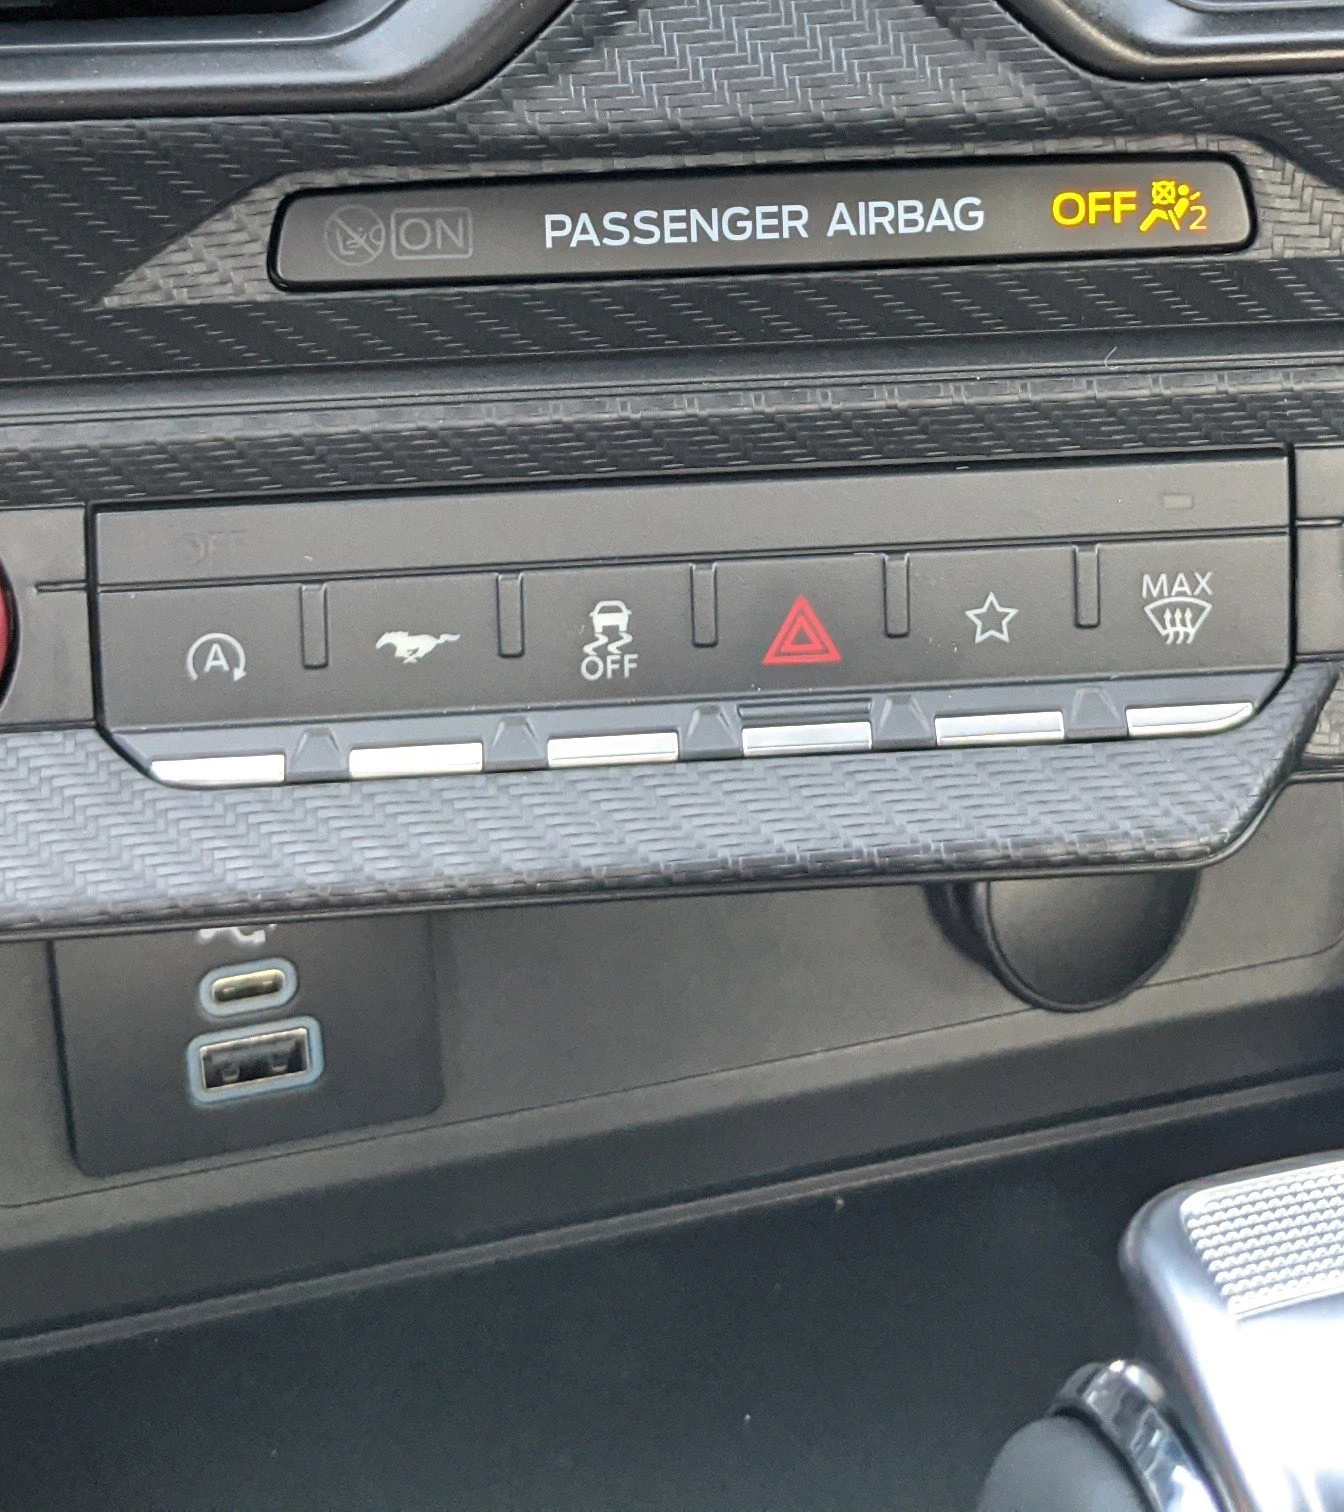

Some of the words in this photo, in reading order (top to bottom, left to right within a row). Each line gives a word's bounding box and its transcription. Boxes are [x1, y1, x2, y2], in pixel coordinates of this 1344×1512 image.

[544, 204, 809, 250] PASSENGER
[826, 197, 985, 238] AIRBAG
[1052, 190, 1138, 227] OFF
[398, 217, 465, 251] ON
[1142, 572, 1213, 599] MAX
[581, 653, 639, 682] OFF
